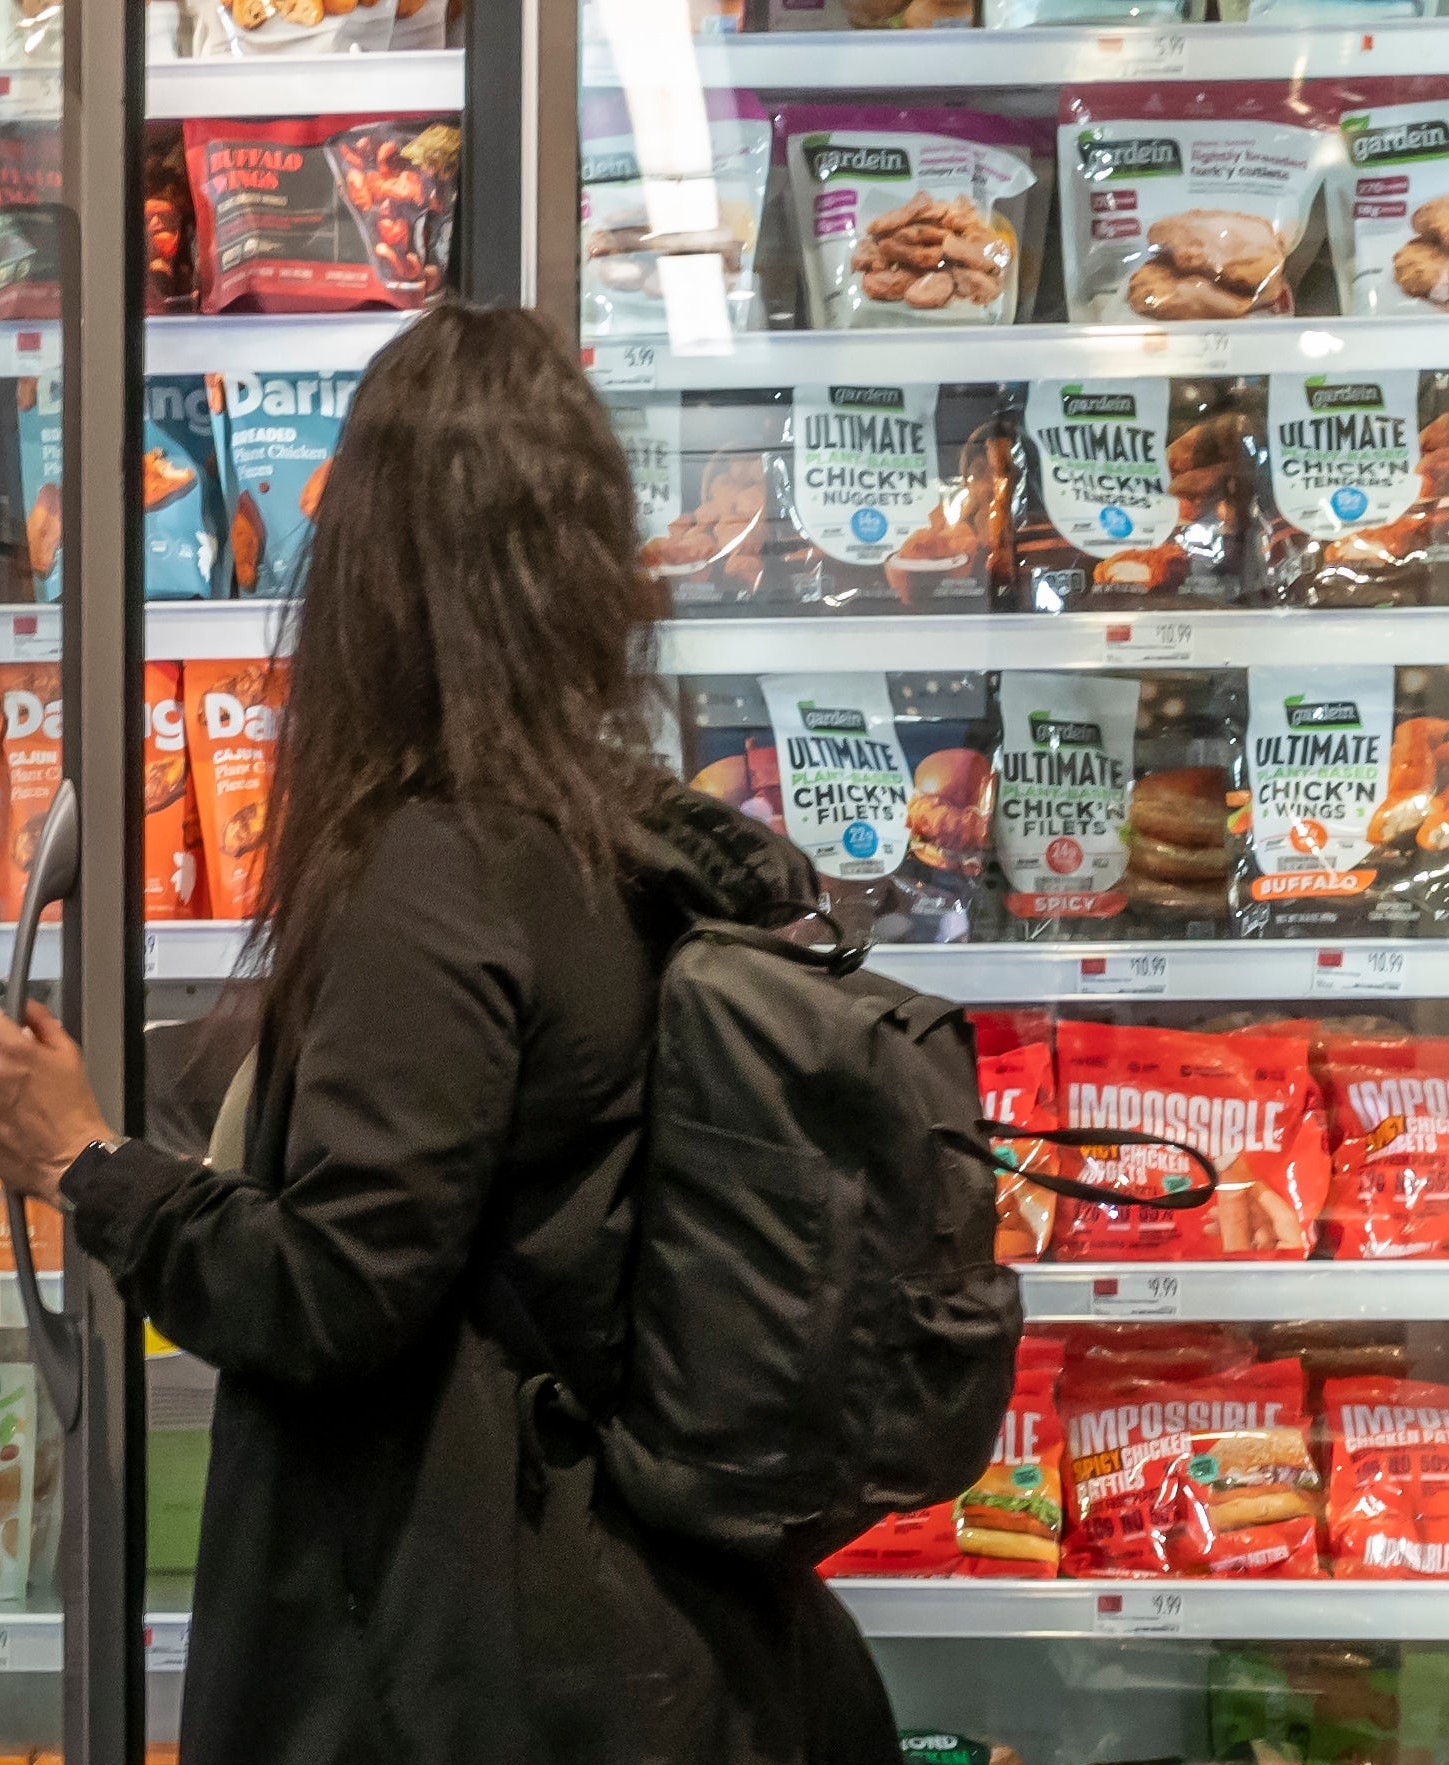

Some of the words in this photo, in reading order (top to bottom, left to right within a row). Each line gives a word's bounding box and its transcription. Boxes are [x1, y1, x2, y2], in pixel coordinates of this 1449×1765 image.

[1353, 124, 1449, 160] gardein
[813, 148, 904, 178] gardein
[232, 427, 298, 444] BREADED
[805, 413, 925, 455] ULTIMATE
[1045, 422, 1157, 464] ULTIMATE
[1279, 414, 1407, 452] ULTIMATE
[267, 443, 328, 461] Chicken
[804, 467, 928, 489] CHICK'N
[1281, 457, 1410, 477] CHICK'N
[1052, 464, 1166, 497] CHICK'N
[822, 490, 914, 507] NUGGETS
[804, 707, 865, 731] gardein
[8, 750, 57, 767] CAJUN
[787, 735, 899, 772] ULTIMATE
[1256, 734, 1381, 767] ULTIMATE
[10, 767, 45, 783] Plant
[214, 765, 251, 781] Plant
[1003, 750, 1124, 790] ULTIMATE
[792, 785, 907, 810] CHICK'N
[1258, 781, 1376, 805] CHICK'N
[816, 805, 896, 825] FILETS
[1005, 798, 1127, 821] CHICK'N
[1273, 803, 1346, 821] WINGS
[1021, 819, 1107, 838] FILETS
[1260, 872, 1359, 896] BUFFALO
[1033, 894, 1097, 914] SPICY
[1067, 1082, 1285, 1155] IMPOSSIBLE
[1069, 1399, 1285, 1458] IMPOSSIBLE
[1346, 1433, 1418, 1453] CHICKEN
[1074, 1453, 1121, 1482] SPICY
[1121, 1431, 1193, 1470] CHICKEN
